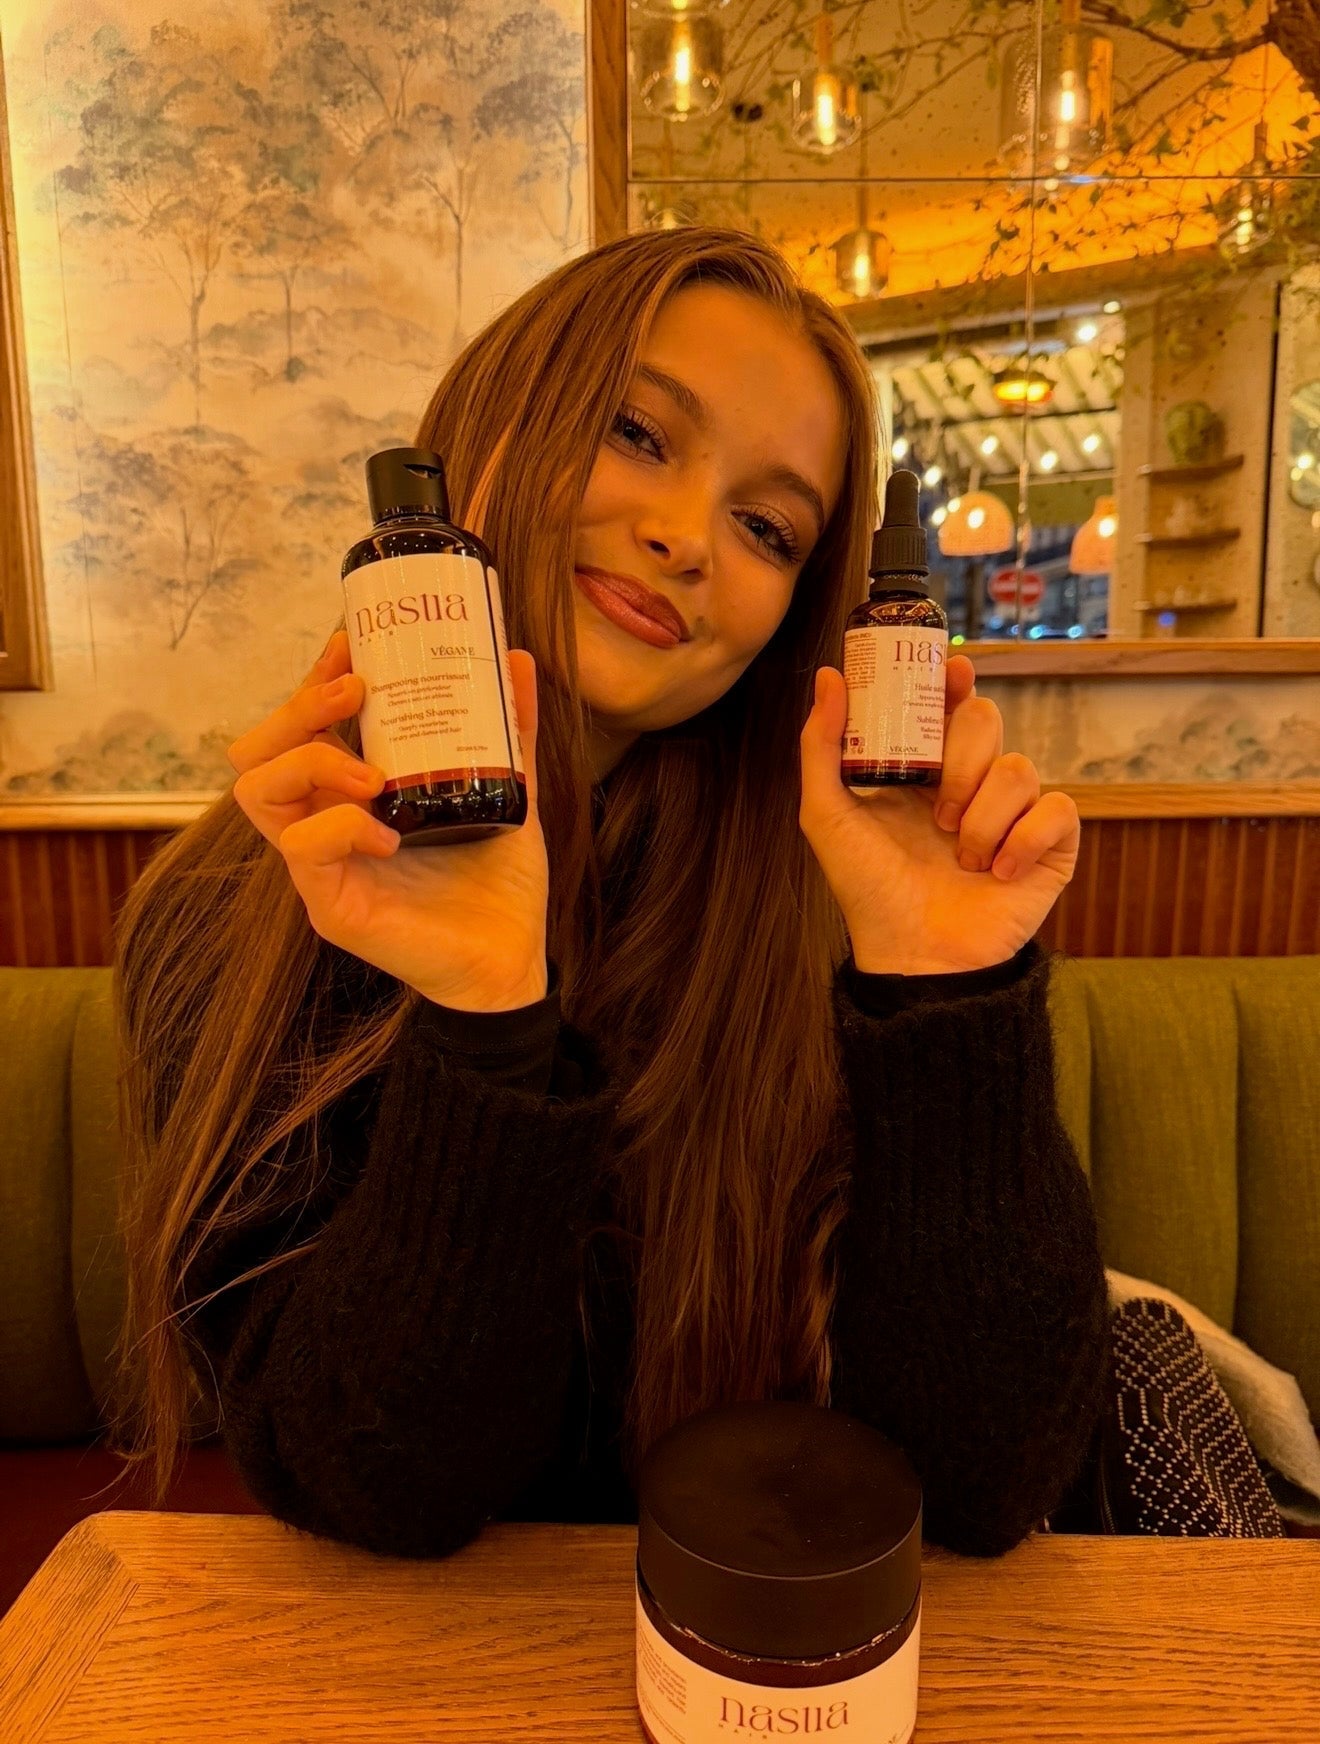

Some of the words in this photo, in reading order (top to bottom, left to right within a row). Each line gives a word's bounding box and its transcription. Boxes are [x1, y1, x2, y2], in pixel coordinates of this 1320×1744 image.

[430, 645, 475, 656] VÉGANE
[371, 677, 419, 694] Shampooing
[420, 672, 470, 683] nourrissant
[380, 710, 424, 727] Nourishing
[425, 708, 469, 719] Shampoo
